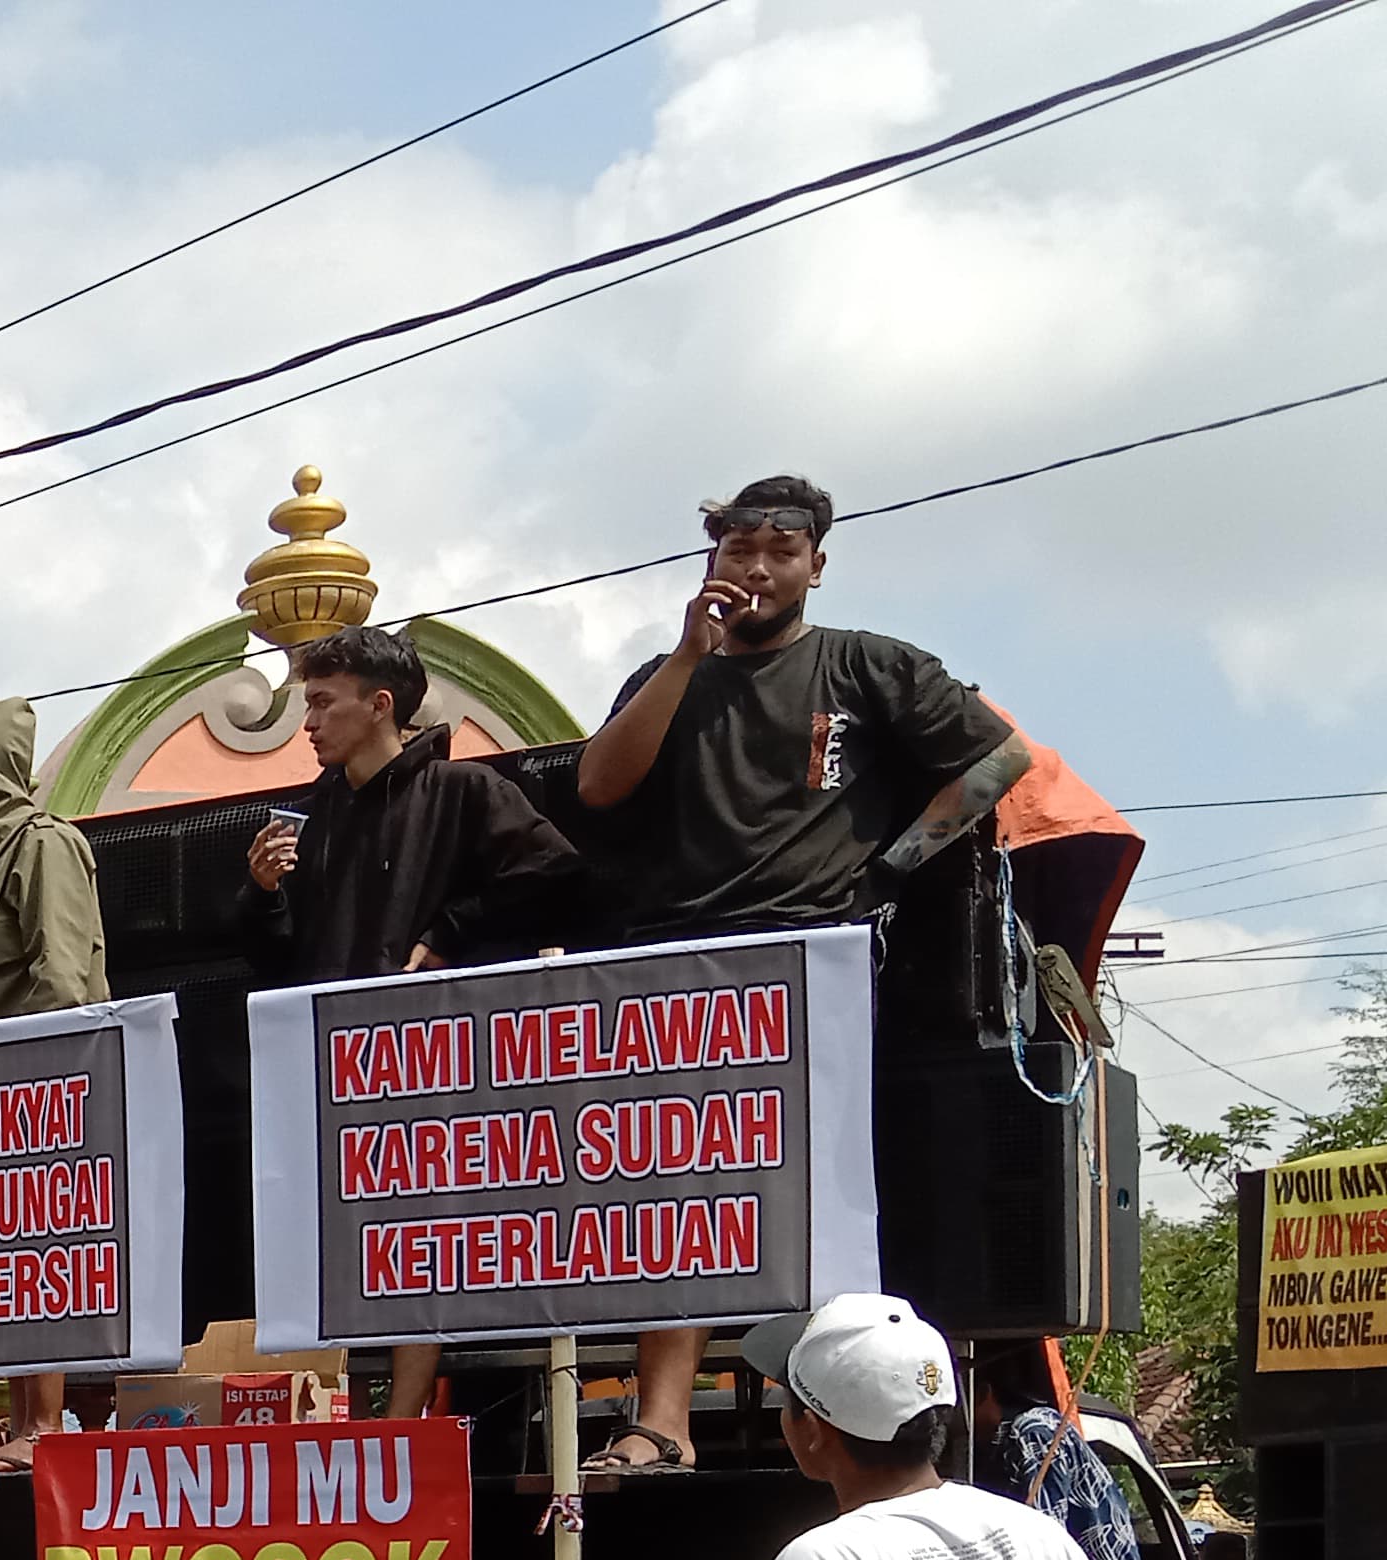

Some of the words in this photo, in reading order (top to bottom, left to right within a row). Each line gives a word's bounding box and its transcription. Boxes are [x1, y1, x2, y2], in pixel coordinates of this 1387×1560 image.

[331, 1017, 474, 1103] KAMI
[489, 983, 789, 1088] MELAWAN
[341, 1109, 564, 1200] KARENA
[576, 1089, 784, 1183] SUDAH
[1274, 1168, 1333, 1205] WOIII
[362, 1195, 760, 1298] KETERLALUAN
[1270, 1216, 1312, 1261] AKU
[1267, 1271, 1325, 1307] MBOK
[1330, 1266, 1387, 1304] GAWE
[1266, 1314, 1302, 1350] TOK
[226, 1391, 243, 1403] ISI
[246, 1389, 289, 1402] TETAP
[234, 1407, 275, 1426] 48
[81, 1442, 270, 1529] JANJI
[294, 1436, 413, 1525] MU
